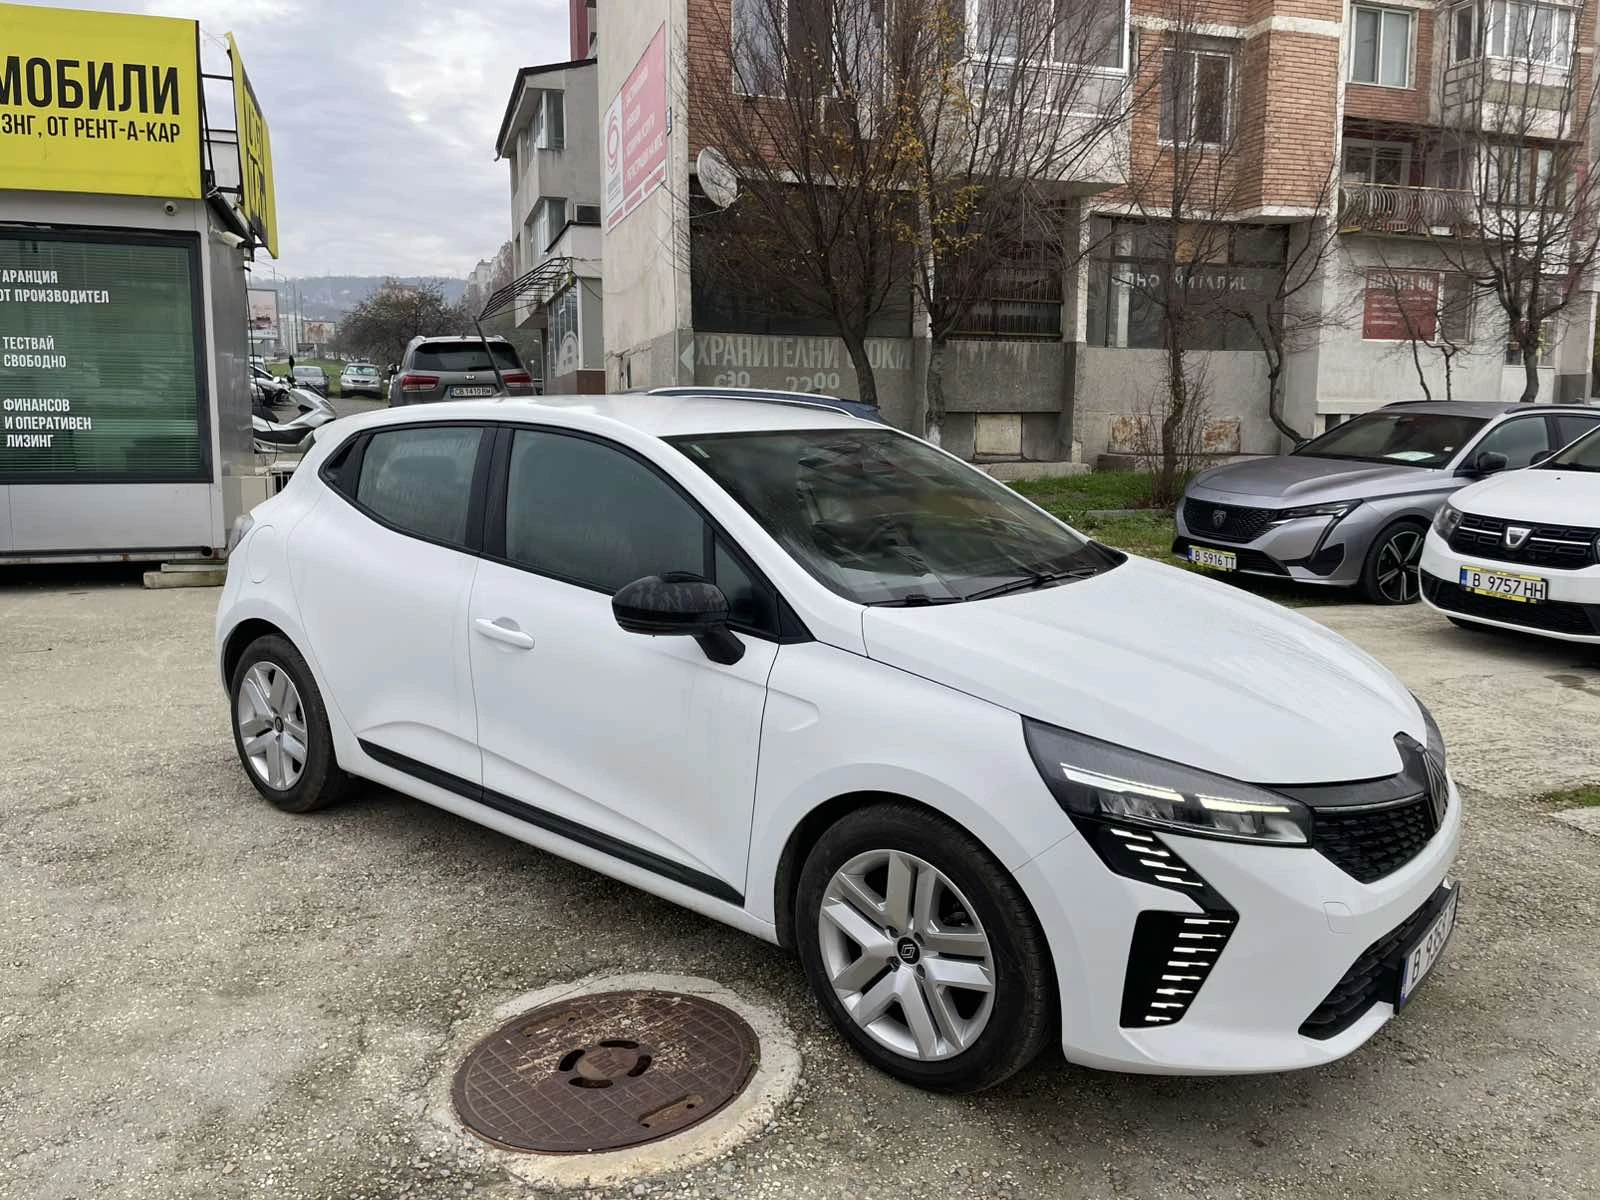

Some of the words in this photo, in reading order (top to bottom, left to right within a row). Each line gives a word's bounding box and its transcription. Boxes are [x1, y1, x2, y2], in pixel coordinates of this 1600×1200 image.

[0, 56, 179, 115] МОБИЛИ
[47, 116, 69, 137] ОТ
[74, 117, 180, 143] РЕНТ-А-КАР
[0, 269, 58, 284] АРАНЦИЯ
[15, 289, 109, 304] ПРОИЗВОДИТЕЛ
[2, 335, 55, 351] ТЕСТВАЙ
[696, 335, 840, 369] ХРАНИТЕЛНИ
[3, 354, 67, 369] СВОБОДНО
[3, 398, 71, 412] ФИНАНСОВ
[4, 416, 13, 430] И
[15, 416, 92, 430] ОПЕРАТИВЕН
[6, 434, 55, 448] ЛИЗИНГ
[1488, 575, 1521, 594] 9757
